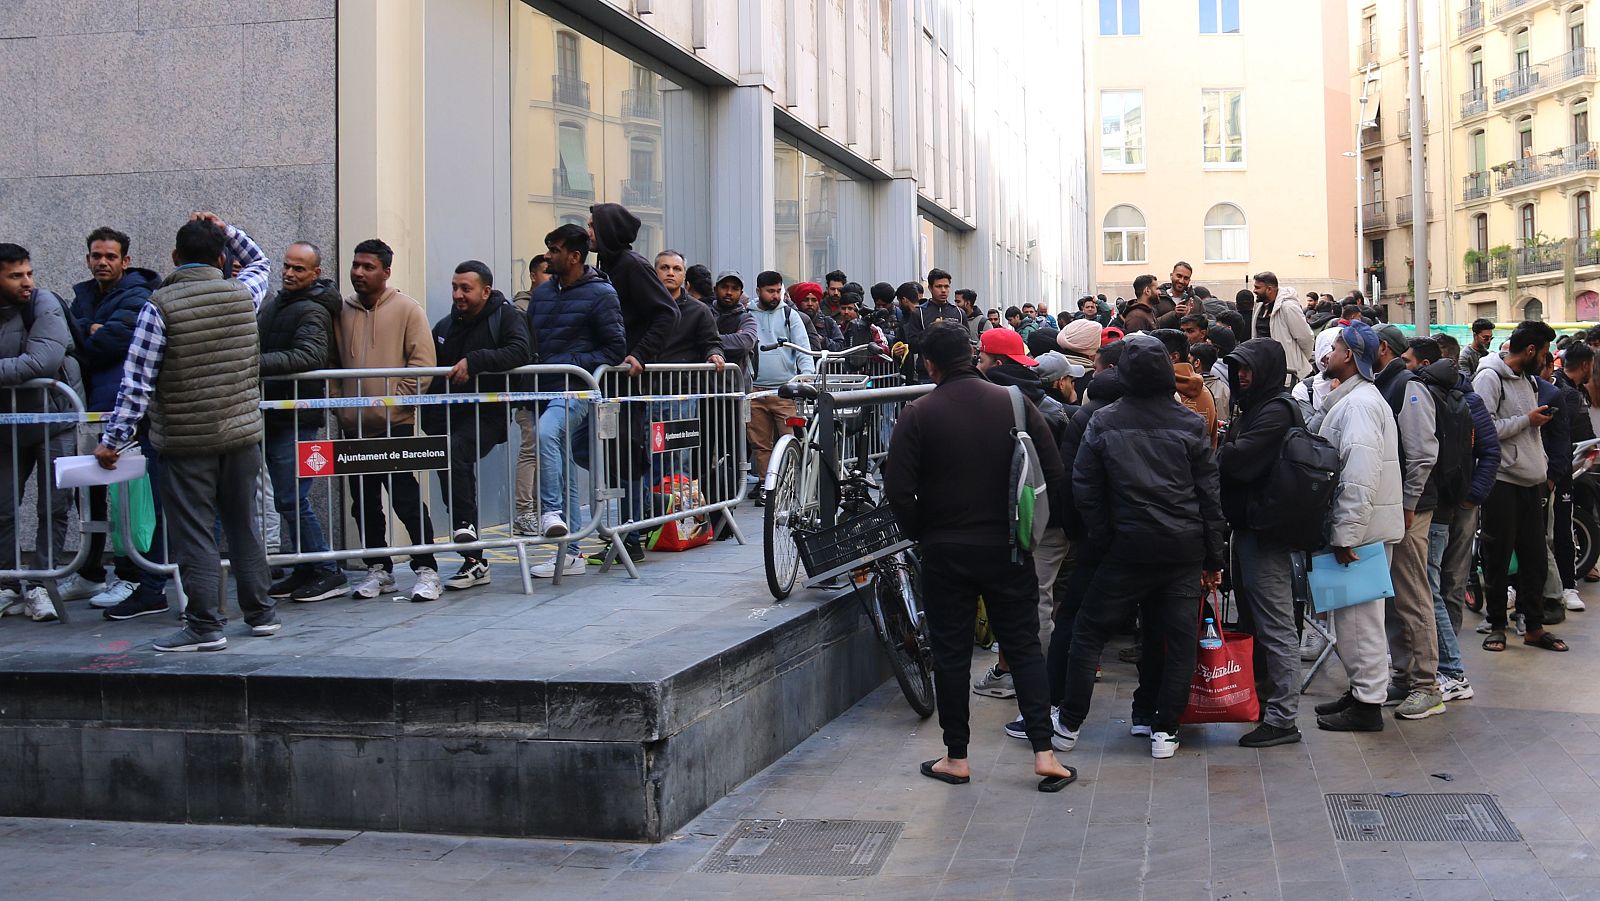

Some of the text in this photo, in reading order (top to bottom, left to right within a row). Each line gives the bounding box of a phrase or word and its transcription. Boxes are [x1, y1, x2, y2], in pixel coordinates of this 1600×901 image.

[337, 449, 445, 464] Ajuntament de Barcelona
